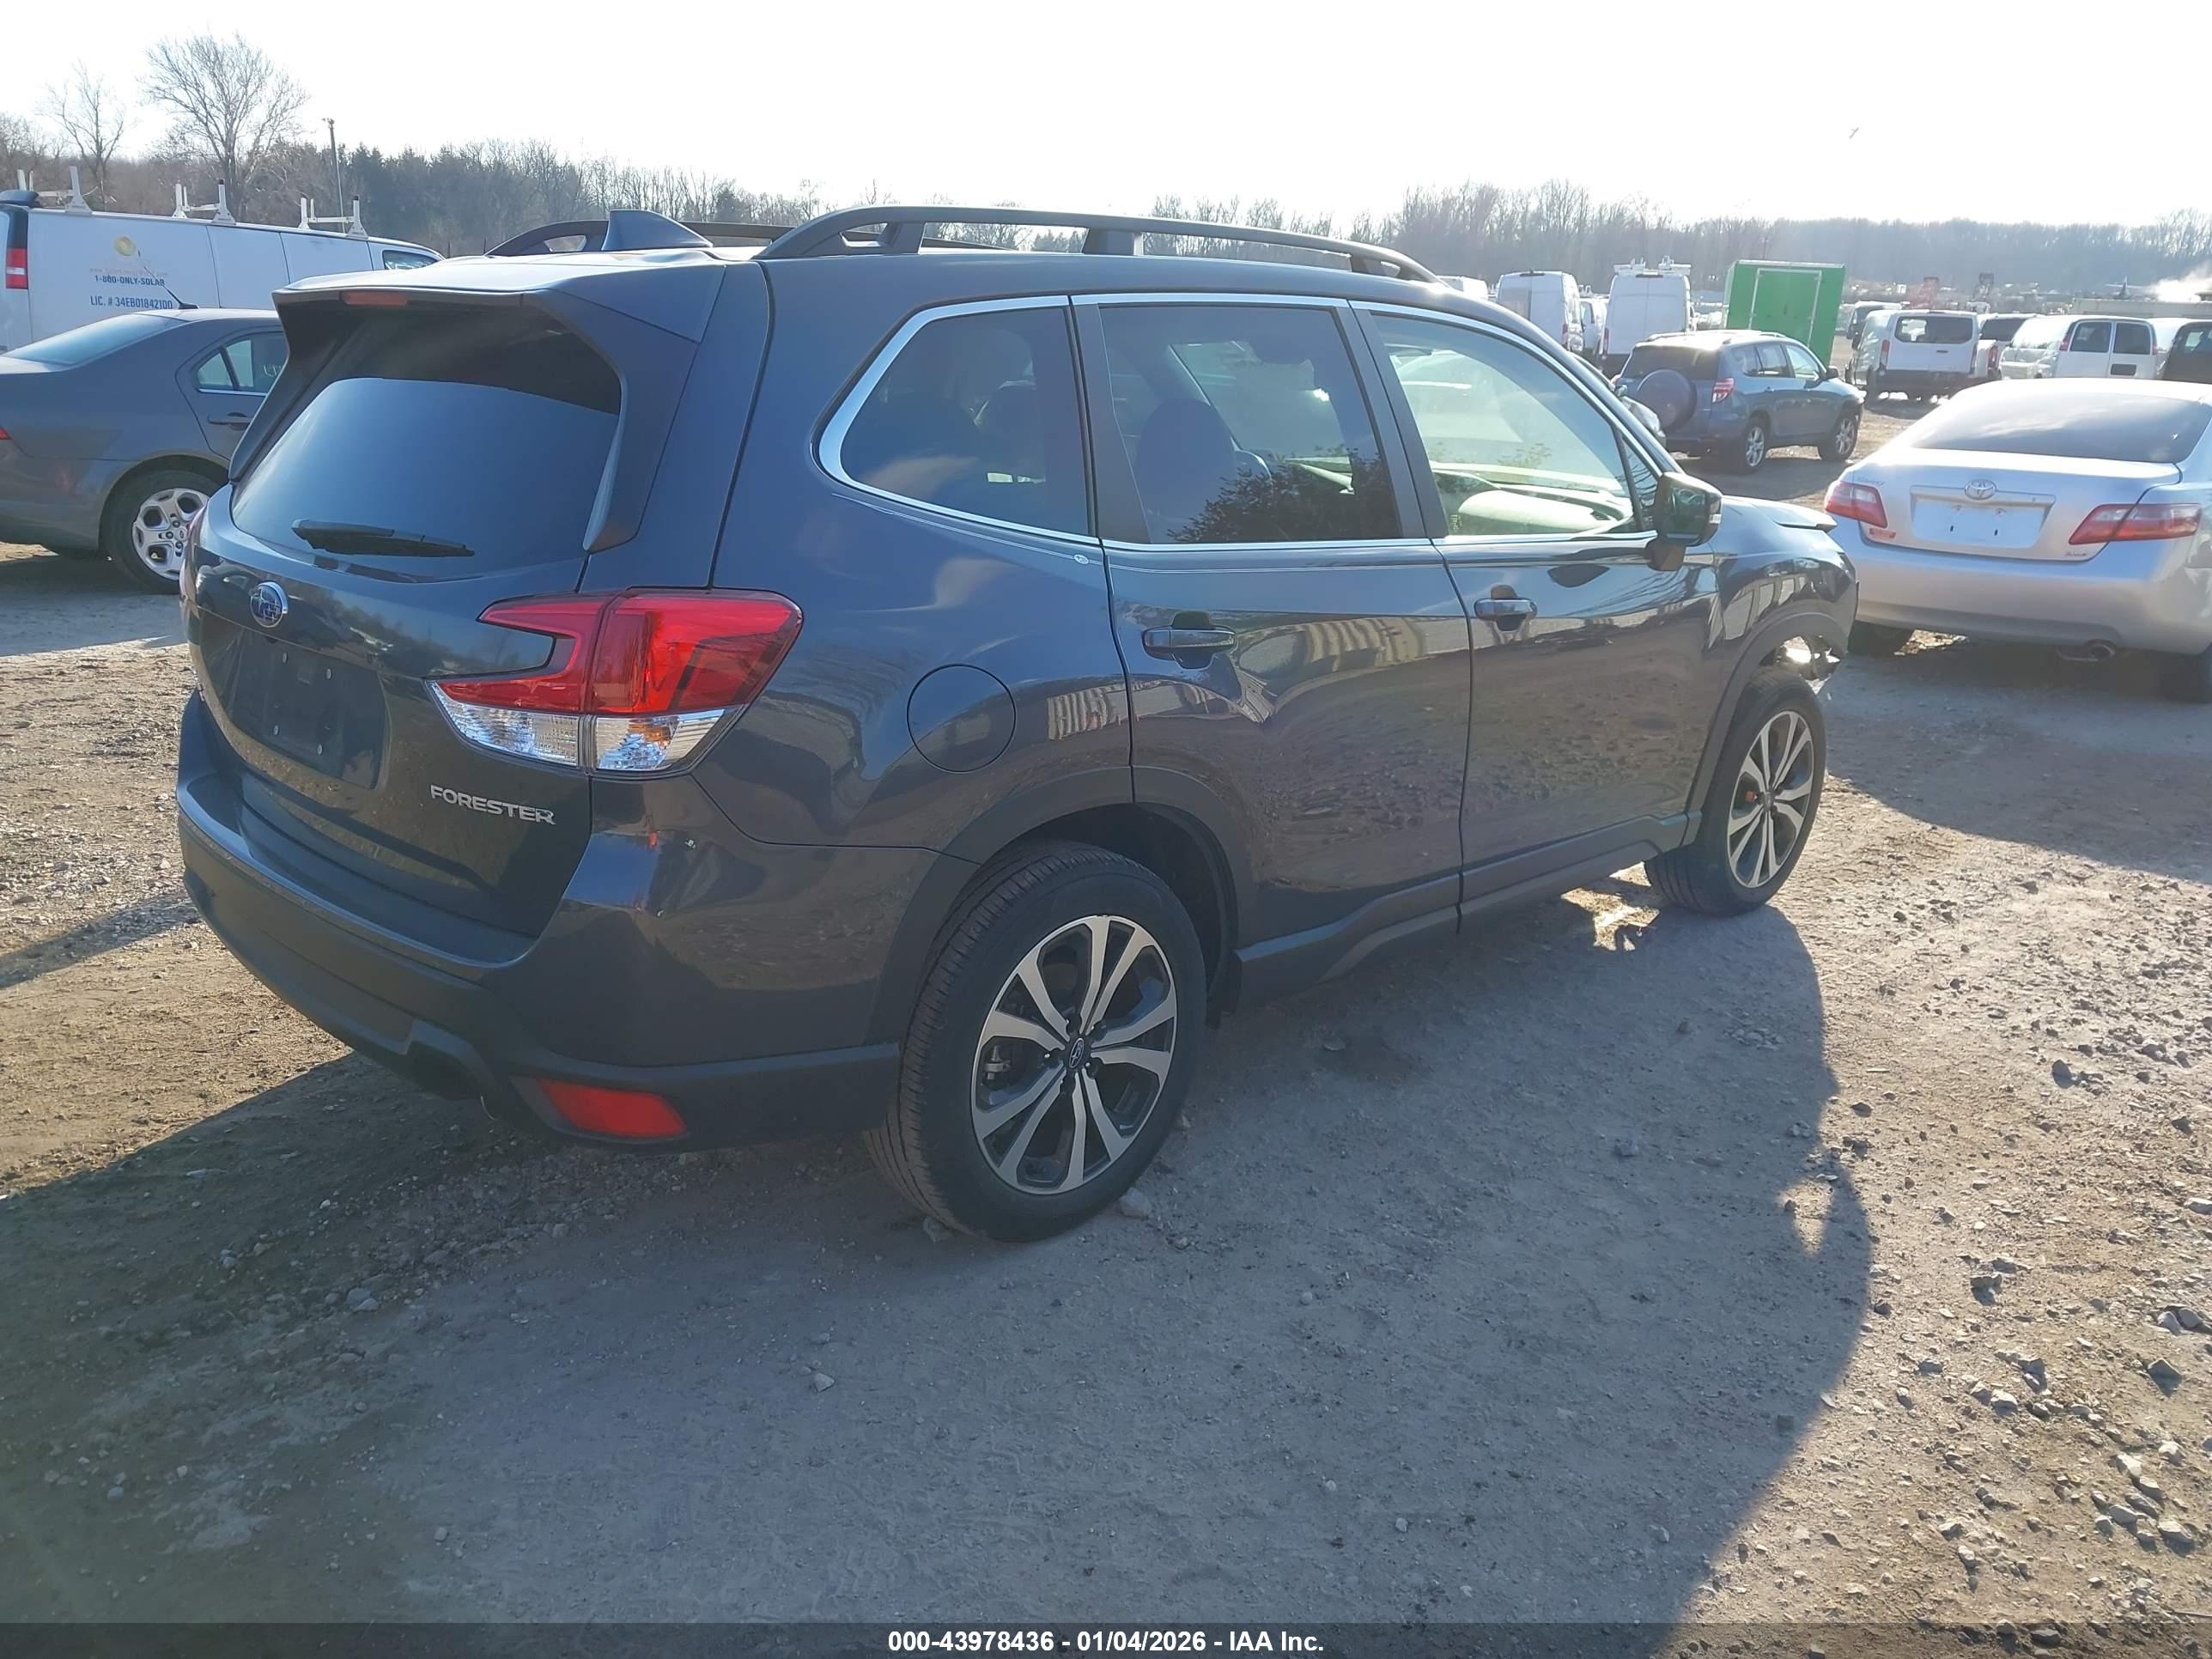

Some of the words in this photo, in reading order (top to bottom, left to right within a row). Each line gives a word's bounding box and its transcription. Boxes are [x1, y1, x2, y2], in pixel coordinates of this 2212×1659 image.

[95, 275, 165, 286] 1-800-ONLY-SOLAR
[90, 295, 106, 307] LIC.
[108, 296, 113, 307] #
[430, 784, 557, 825] FORESTER
